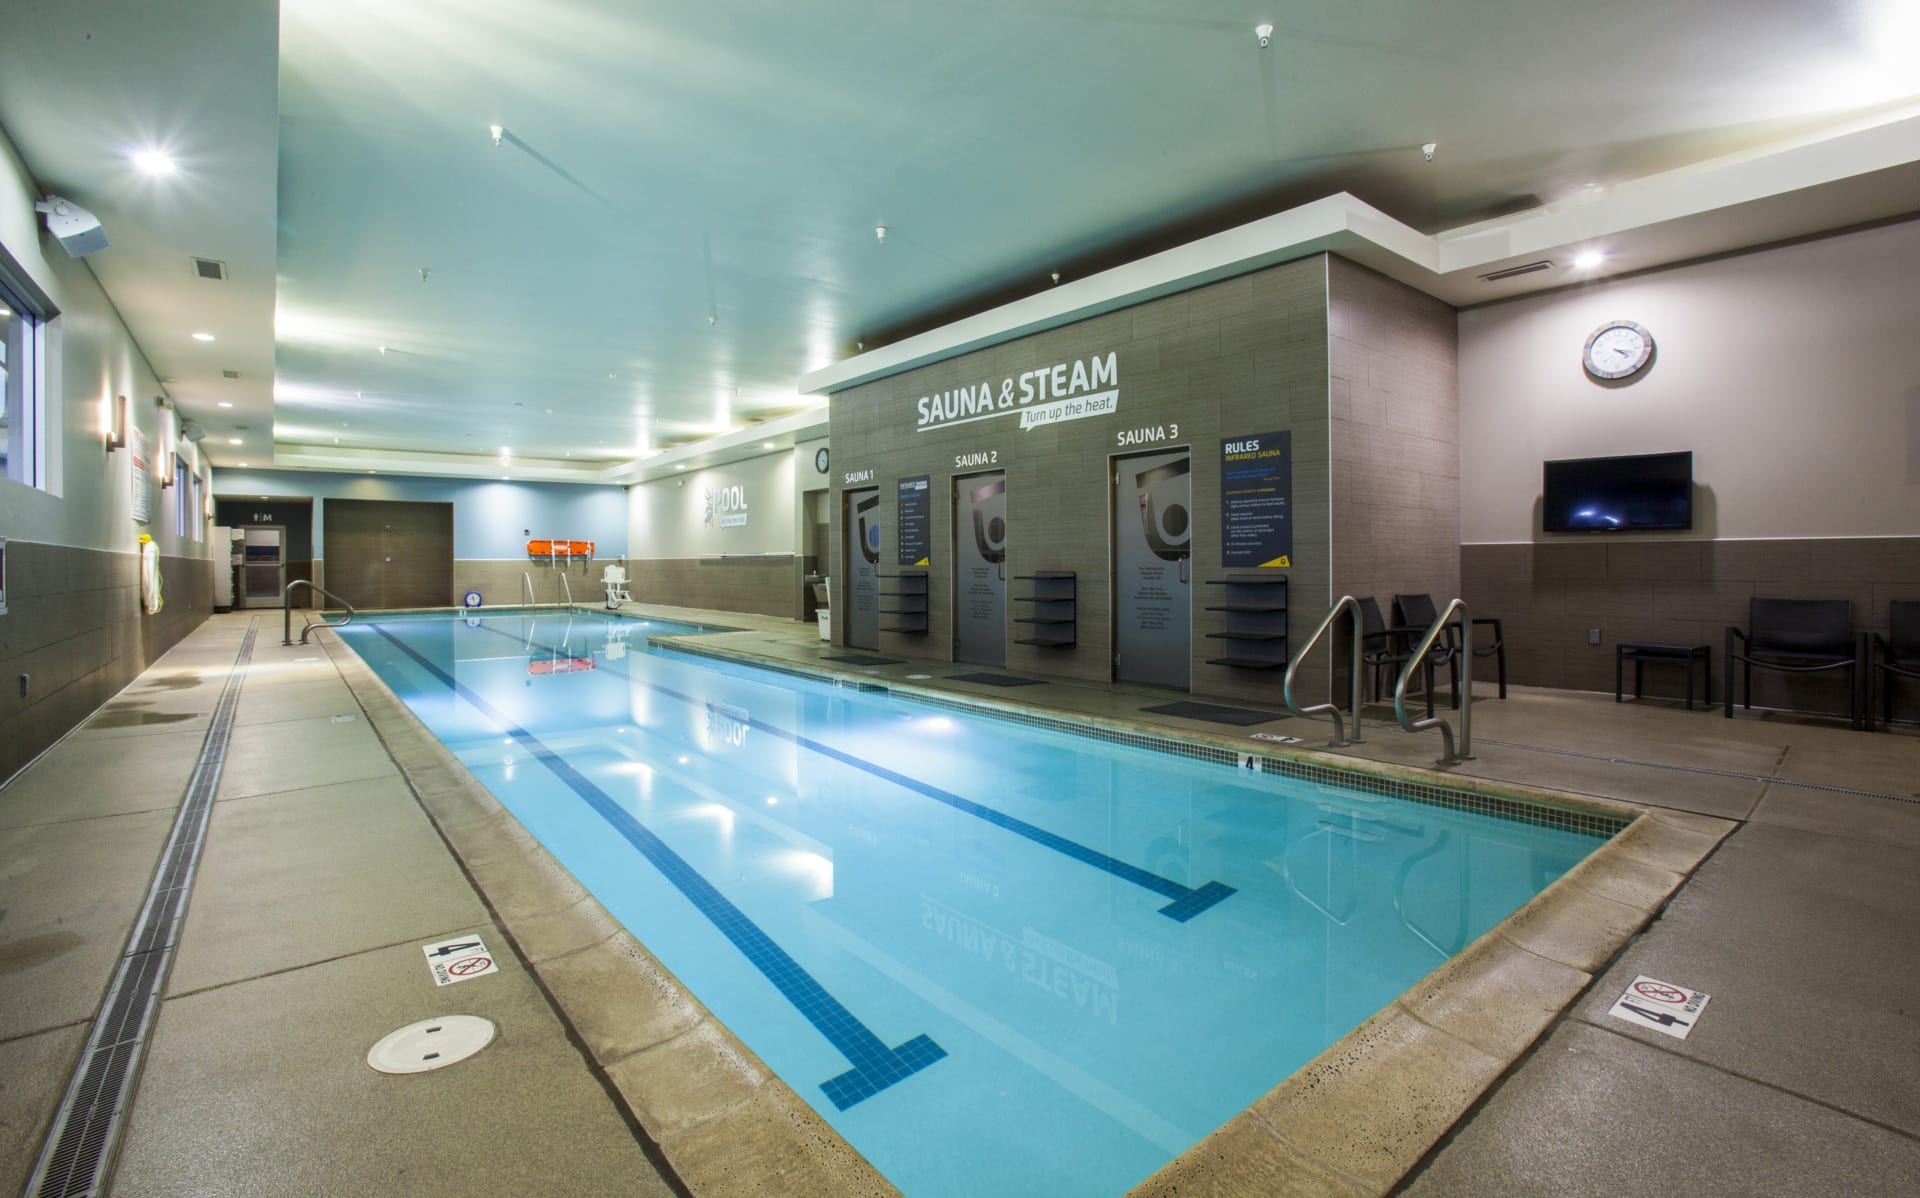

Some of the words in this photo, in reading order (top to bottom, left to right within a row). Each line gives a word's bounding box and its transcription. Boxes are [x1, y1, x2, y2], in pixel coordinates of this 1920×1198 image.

[918, 382, 994, 425] SAUNA
[998, 378, 1014, 409] &
[1019, 352, 1118, 404] STEAM
[1026, 410, 1046, 423] Turn
[1050, 408, 1062, 421] up
[1065, 401, 1081, 416] the
[1085, 396, 1113, 412] heat.
[1117, 426, 1166, 446] SAUNA
[1169, 424, 1179, 439] 3
[1225, 440, 1260, 454] RULES
[1225, 452, 1257, 461] INFRARED
[1258, 449, 1281, 458] SAUNA
[955, 452, 988, 468] SAUNA
[991, 451, 998, 463] 2
[845, 470, 869, 484] SAUNA
[870, 469, 874, 480] 1
[1245, 756, 1254, 770] 4
[428, 941, 481, 958] 4
[1619, 1001, 1690, 1027] 4
